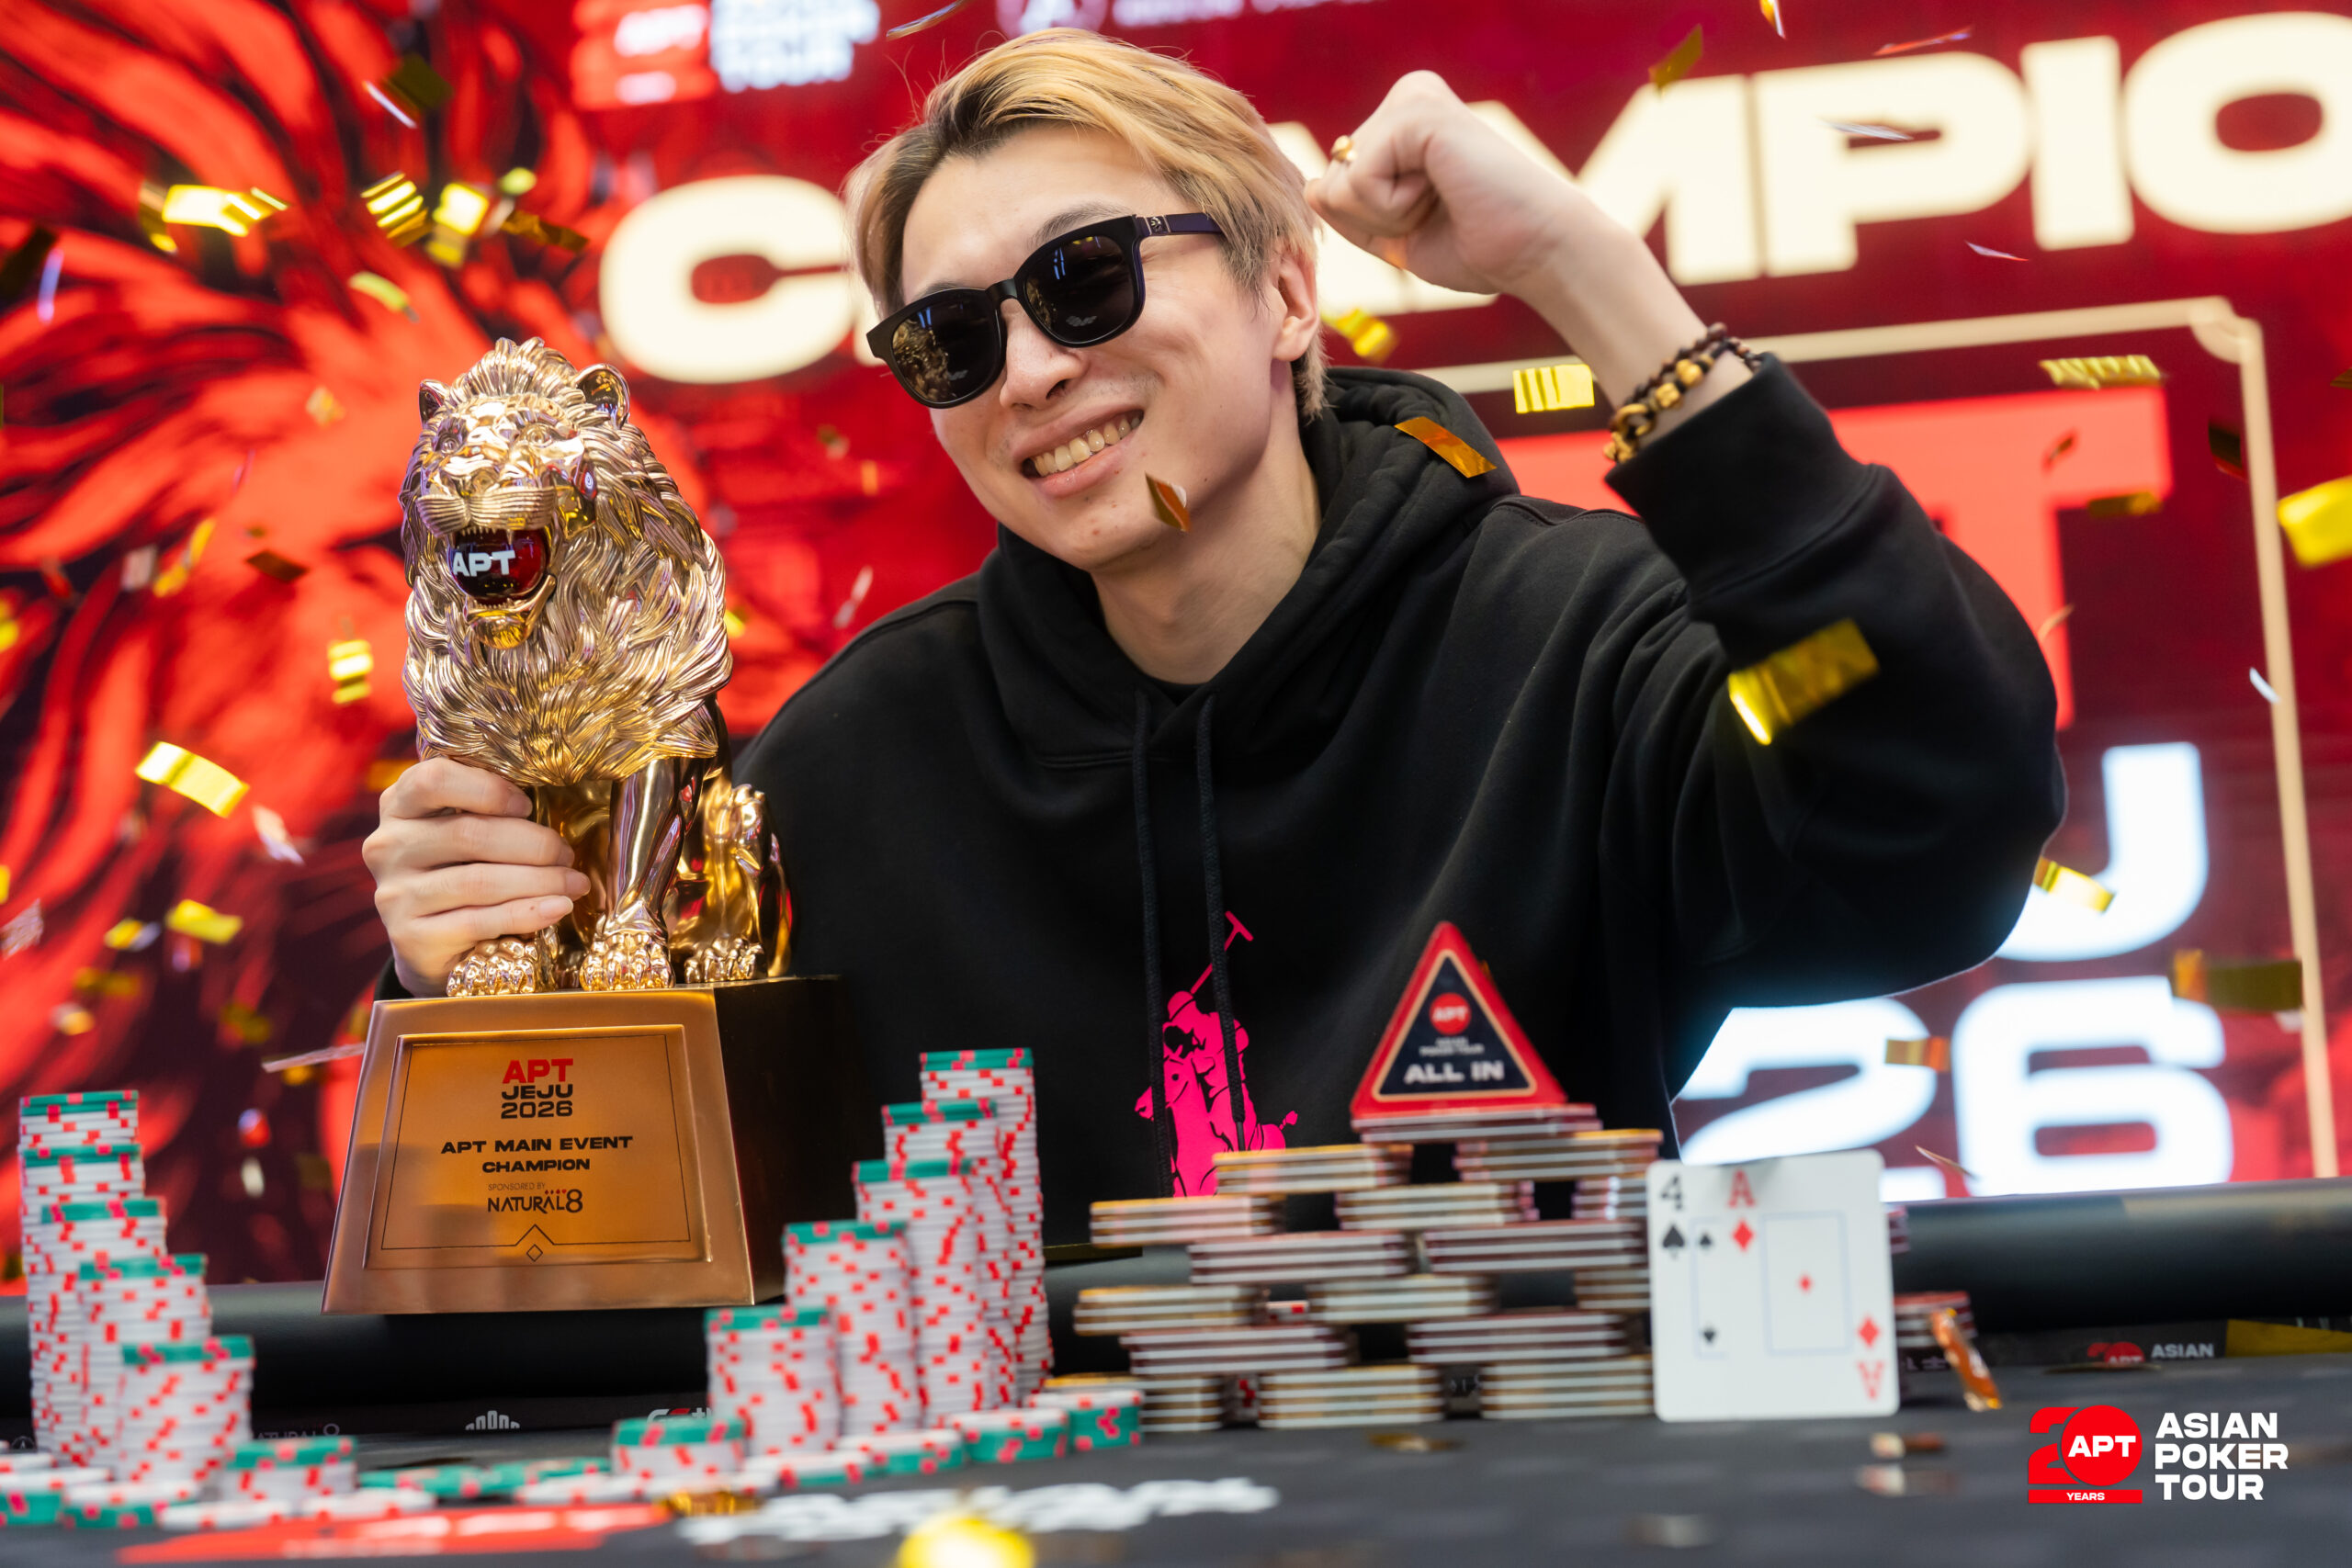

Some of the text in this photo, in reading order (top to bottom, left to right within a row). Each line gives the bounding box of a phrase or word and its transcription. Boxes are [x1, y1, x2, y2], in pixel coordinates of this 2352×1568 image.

[599, 13, 2352, 384] CMPIO
[453, 550, 515, 577] APT
[1431, 1005, 1469, 1021] APT
[503, 1058, 574, 1084] APT
[1403, 1060, 1505, 1084] ALL IN
[501, 1084, 573, 1100] JEJU
[501, 1100, 573, 1120] 2026
[441, 1136, 634, 1154] APT MAIN EVENT
[482, 1158, 591, 1173] CHAMPION
[487, 1181, 546, 1191] SPONSORED BY
[1661, 1174, 1683, 1212] 4
[1727, 1168, 1757, 1210] A
[2151, 1342, 2214, 1359] ASIAN
[1856, 1360, 1885, 1401] A
